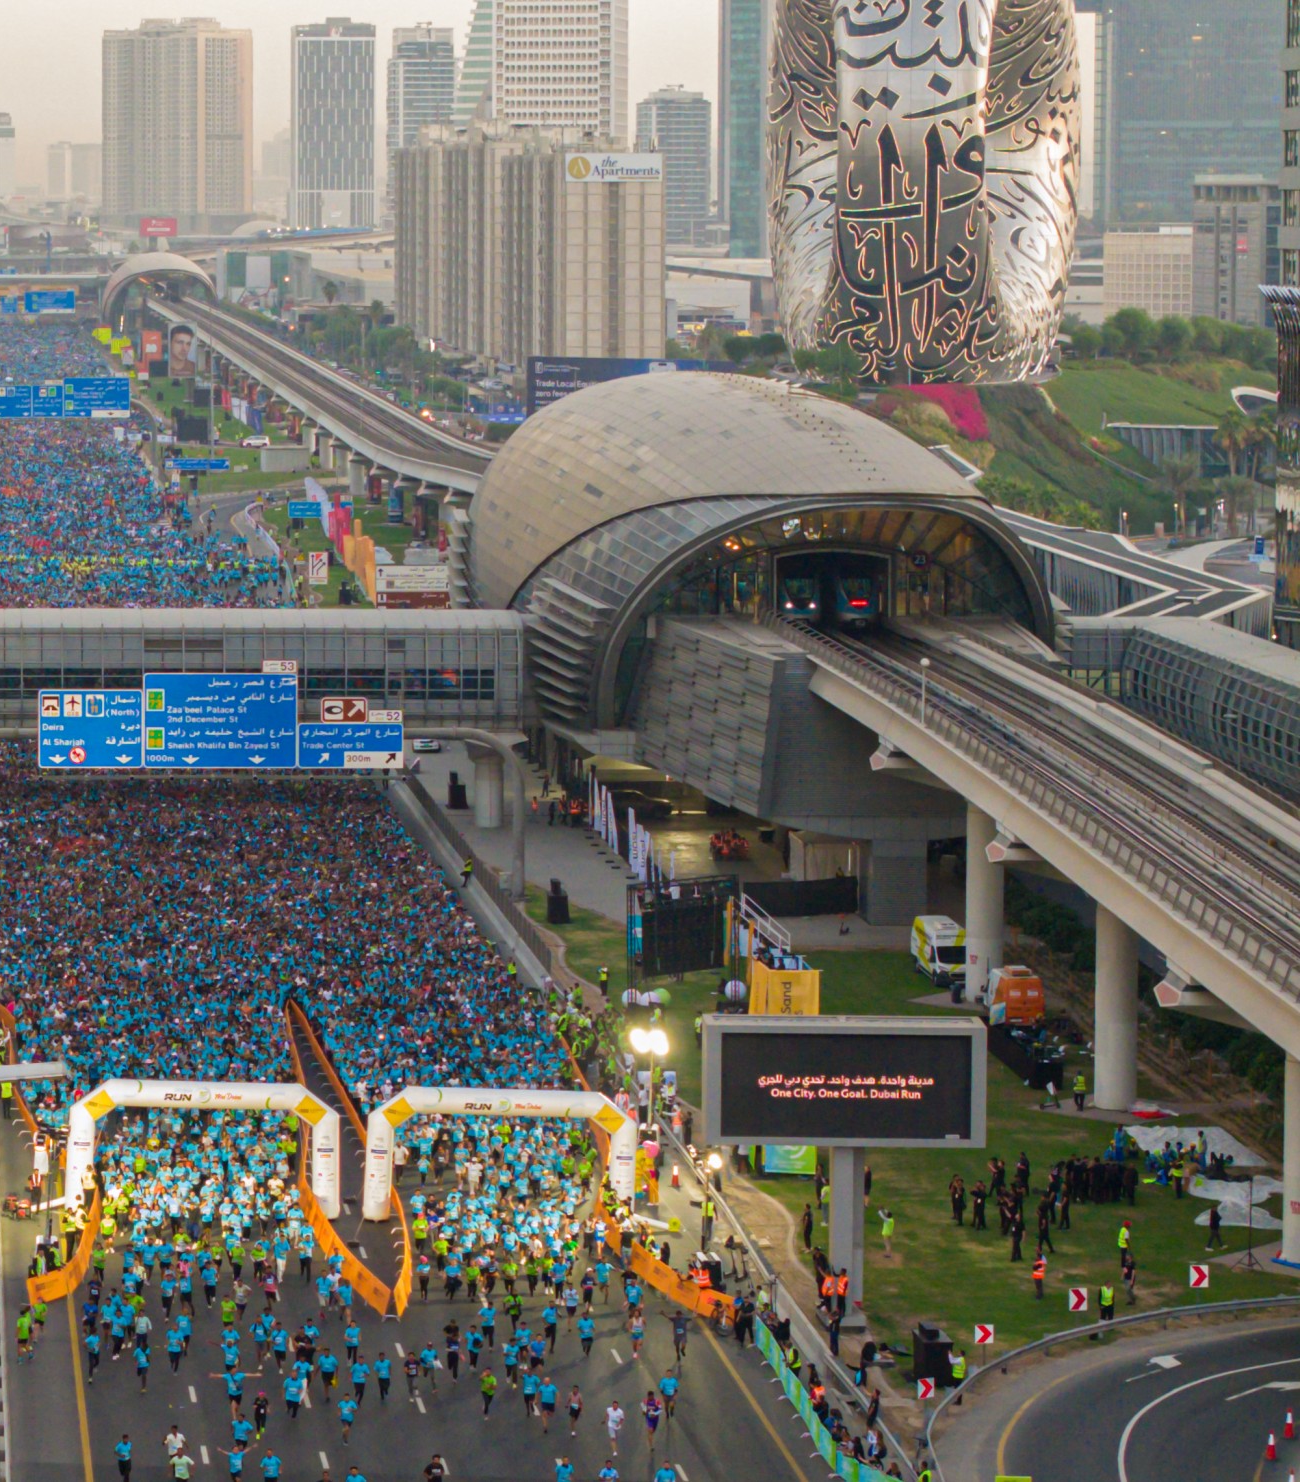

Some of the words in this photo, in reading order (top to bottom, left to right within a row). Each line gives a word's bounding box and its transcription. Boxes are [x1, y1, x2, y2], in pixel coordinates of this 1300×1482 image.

[602, 156, 617, 167] the
[592, 165, 660, 179] Apartments
[281, 662, 294, 671] 53
[206, 706, 235, 714] Palace
[238, 706, 247, 714] St
[167, 715, 182, 723] 2nd
[185, 715, 226, 723] December
[386, 712, 400, 720] 52
[42, 723, 64, 731] Deira
[42, 738, 51, 746] Al
[54, 738, 85, 747] Sharjah
[244, 742, 268, 750] Zayed
[780, 981, 792, 1014] Sand
[758, 1074, 783, 1088] للجري
[784, 1076, 800, 1088] دبي
[802, 1075, 826, 1088] تحدي
[852, 1075, 876, 1085] هدف
[908, 1075, 934, 1088] مدينة
[771, 1088, 791, 1098] One
[794, 1088, 816, 1100] City.
[818, 1088, 839, 1098] One
[841, 1088, 868, 1099] Goal.
[870, 1089, 900, 1099] Dubai
[901, 1089, 921, 1099] Run
[464, 1102, 492, 1110] RUN
